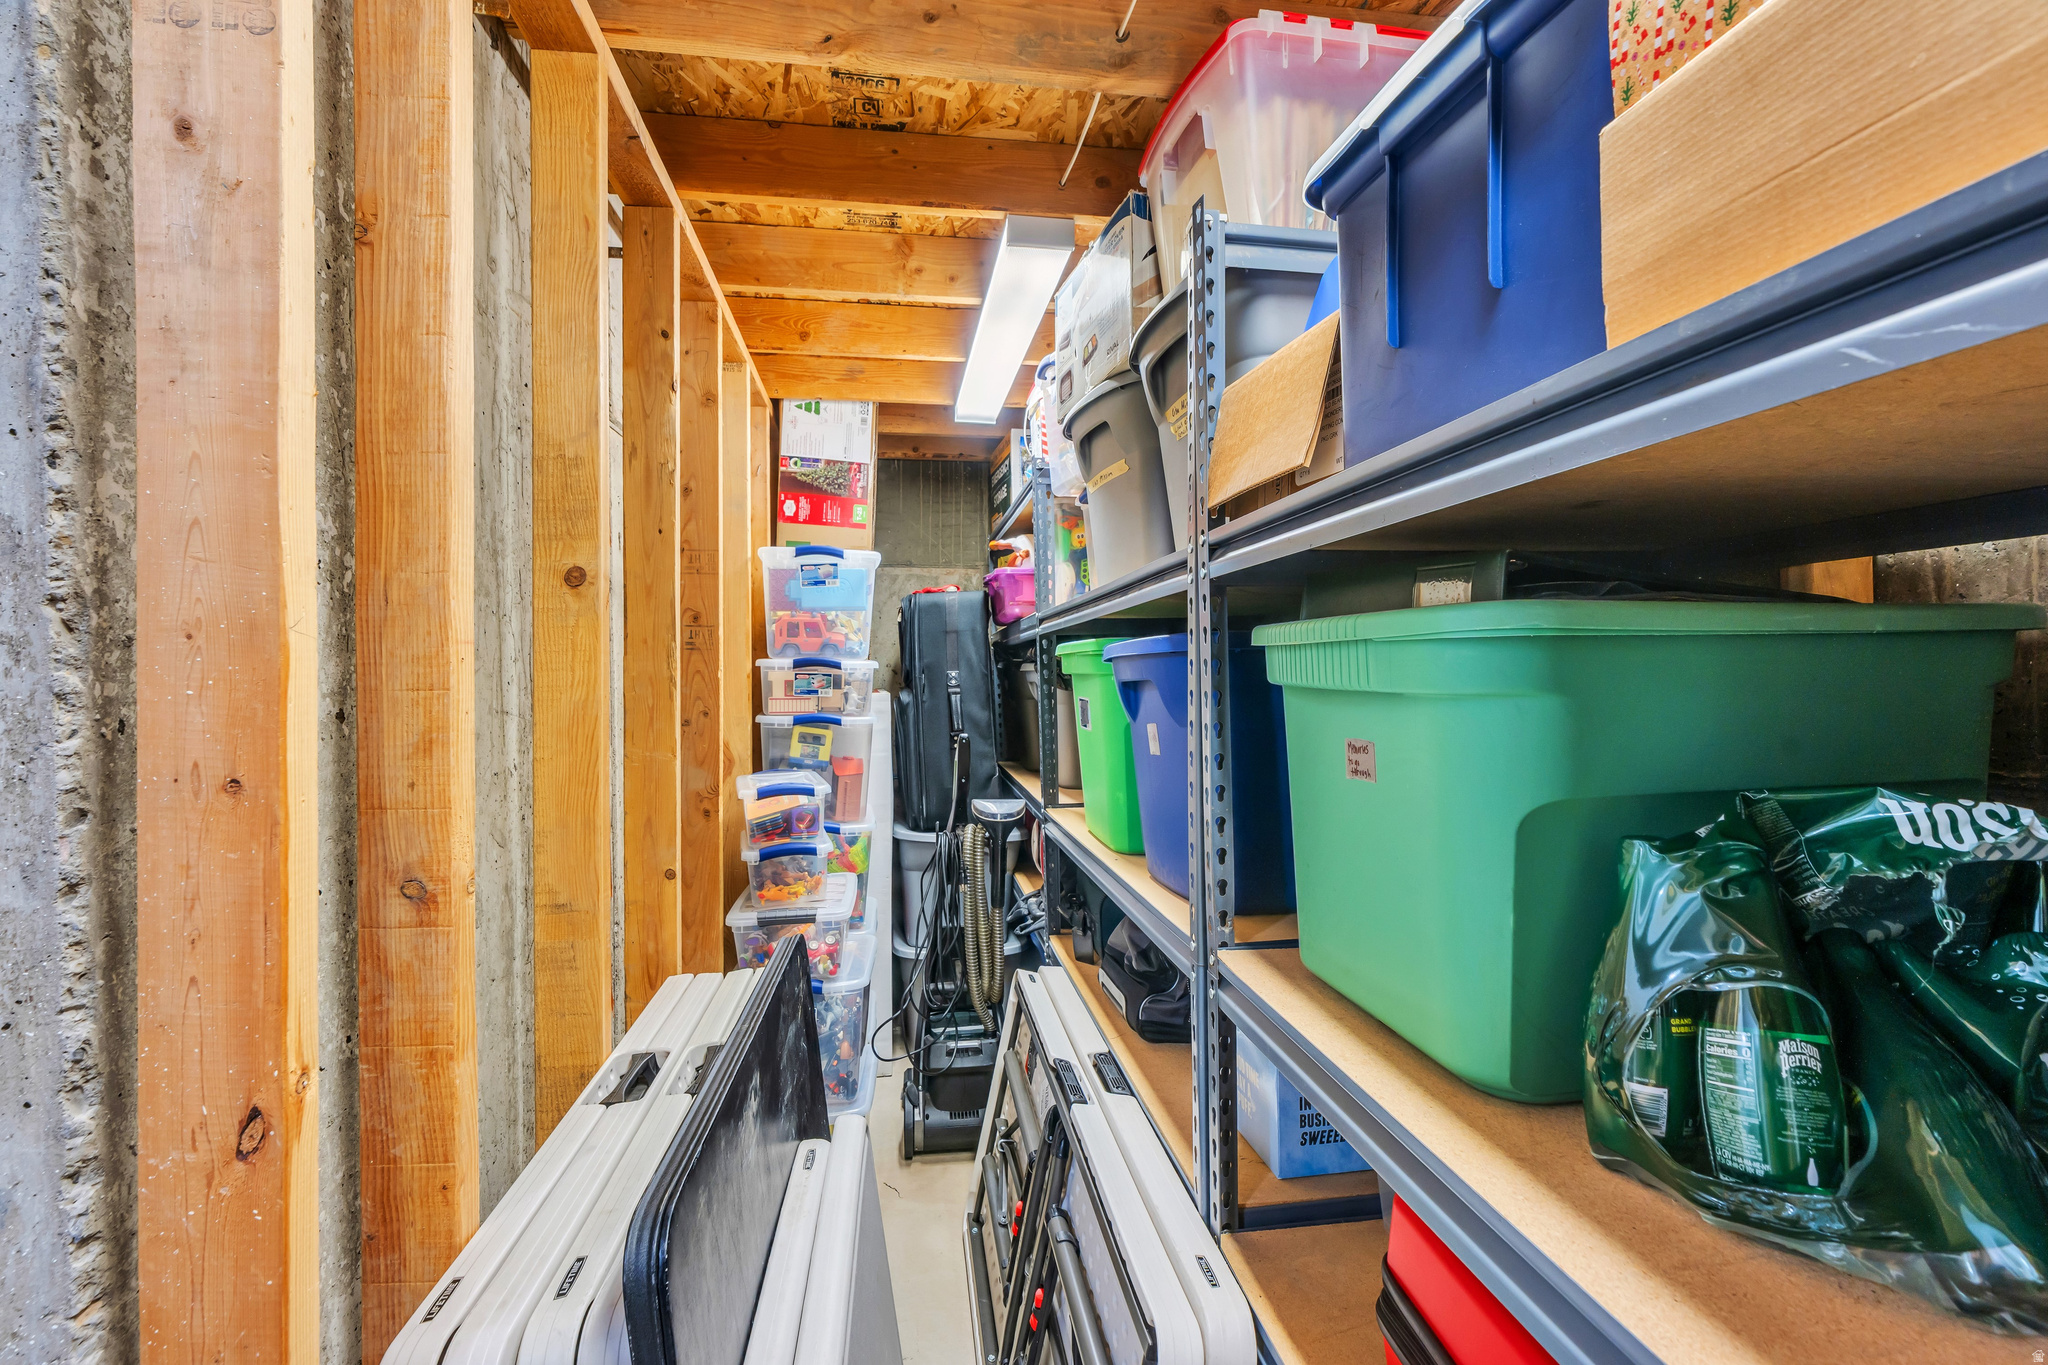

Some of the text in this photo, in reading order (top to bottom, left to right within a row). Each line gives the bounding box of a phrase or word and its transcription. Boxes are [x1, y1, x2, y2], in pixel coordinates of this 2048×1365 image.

[1106, 339, 1120, 357] RIVAL
[1706, 1043, 1751, 1058] Calories 0
[1778, 1038, 1821, 1061] Maison
[1299, 1112, 1331, 1129] BUSI
[559, 1261, 583, 1296] LIFETIME
[426, 1280, 459, 1320] LIFETIME
